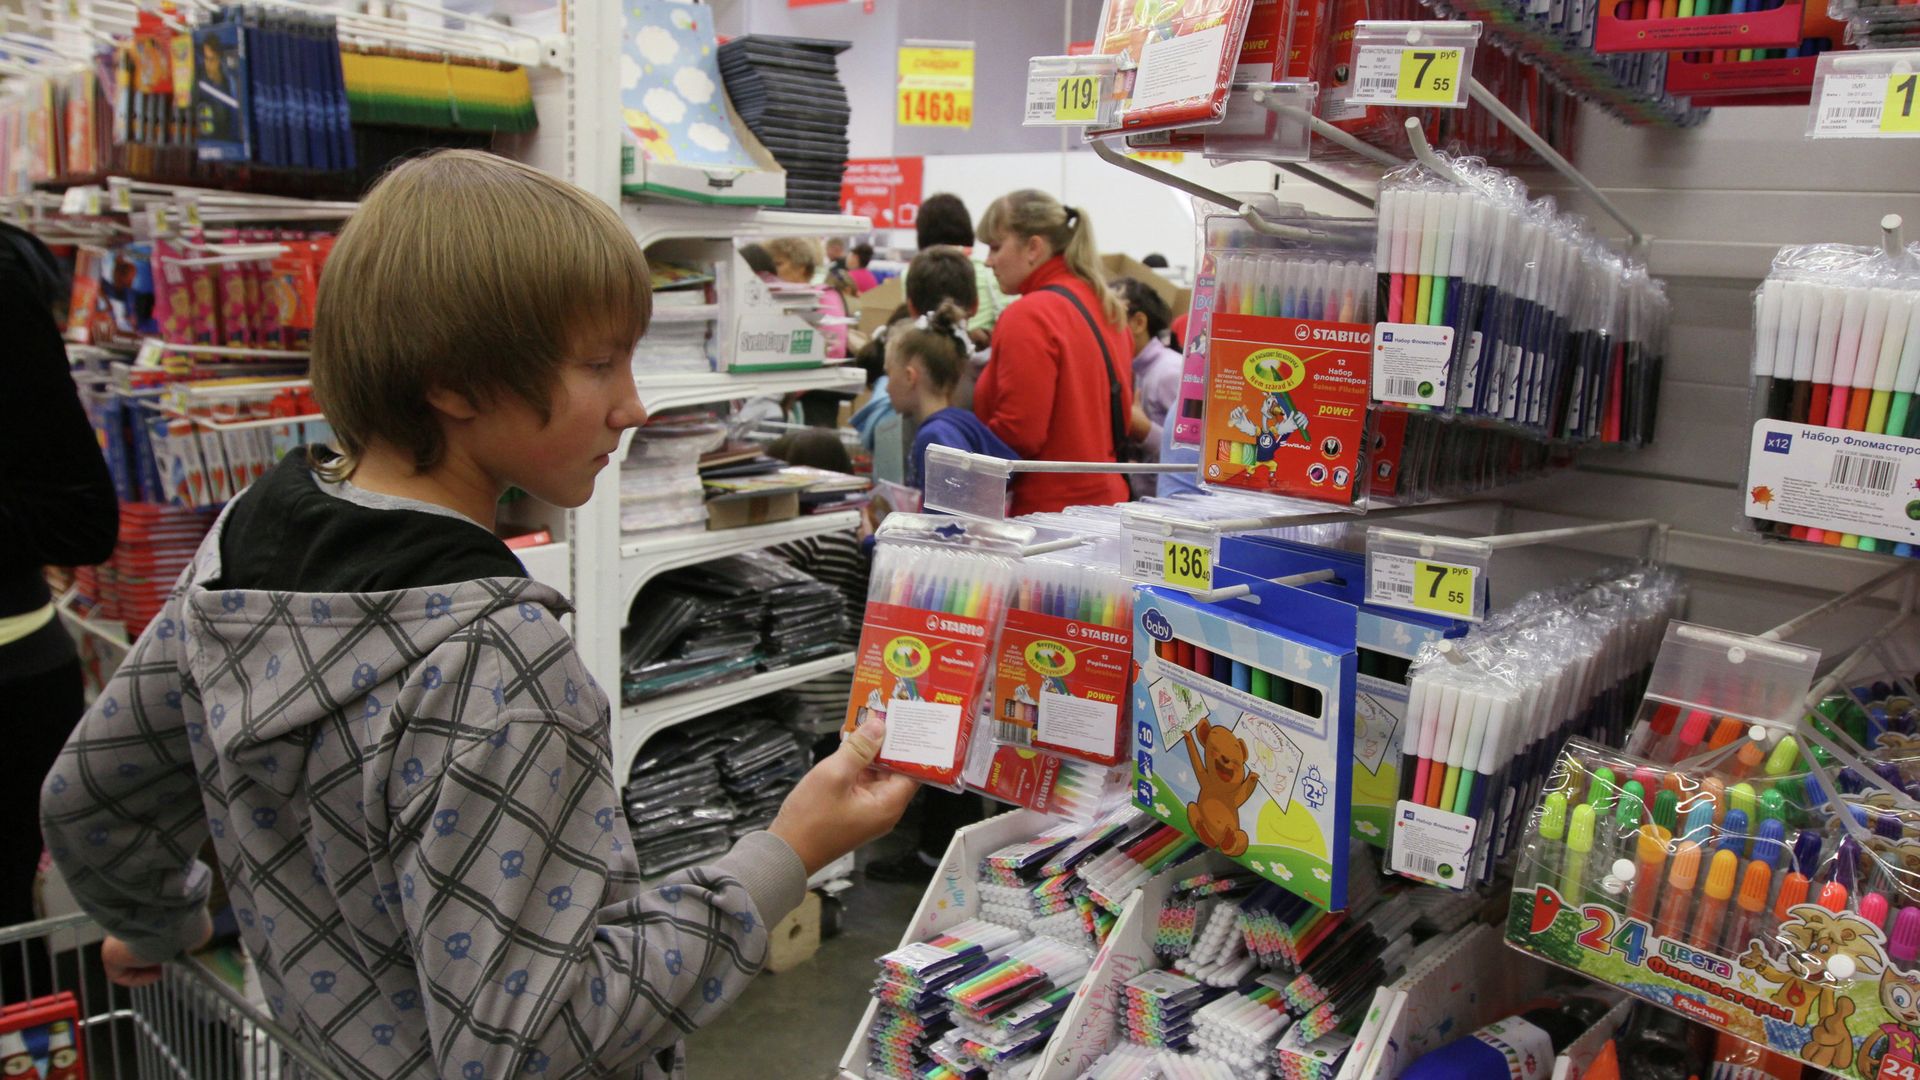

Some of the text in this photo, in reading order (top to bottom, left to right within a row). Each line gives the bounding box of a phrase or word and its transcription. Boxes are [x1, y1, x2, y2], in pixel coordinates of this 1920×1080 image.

[1243, 39, 1269, 51] ower
[1413, 50, 1457, 91] 7 руб 55
[1061, 78, 1093, 110] 119
[1896, 75, 1918, 117] 1
[903, 91, 955, 123] 1463
[1312, 328, 1371, 344] STABILO
[1412, 338, 1447, 346] Фломастеров
[1313, 373, 1367, 385] фломастеров
[1328, 368, 1353, 377] Набор
[1318, 404, 1354, 416] power
[1767, 438, 1789, 449] x12
[1801, 430, 1840, 445] Набор
[1168, 544, 1202, 579] 136
[1202, 570, 1210, 581] 40
[1426, 565, 1468, 604] 7 руб 55
[940, 619, 985, 637] STABILO
[1080, 627, 1128, 645] STABILO
[1146, 615, 1169, 639] baby
[934, 692, 963, 704] power
[1086, 690, 1116, 702] power
[991, 761, 1002, 787] power
[1036, 769, 1054, 809] STABILO
[1305, 784, 1322, 799] 2+
[1576, 906, 1648, 966] 24
[1659, 940, 1733, 980] цвета
[1646, 955, 1795, 1024] Фломастеры
[1677, 997, 1725, 1024] Auchan
[1883, 1059, 1916, 1080] 24
